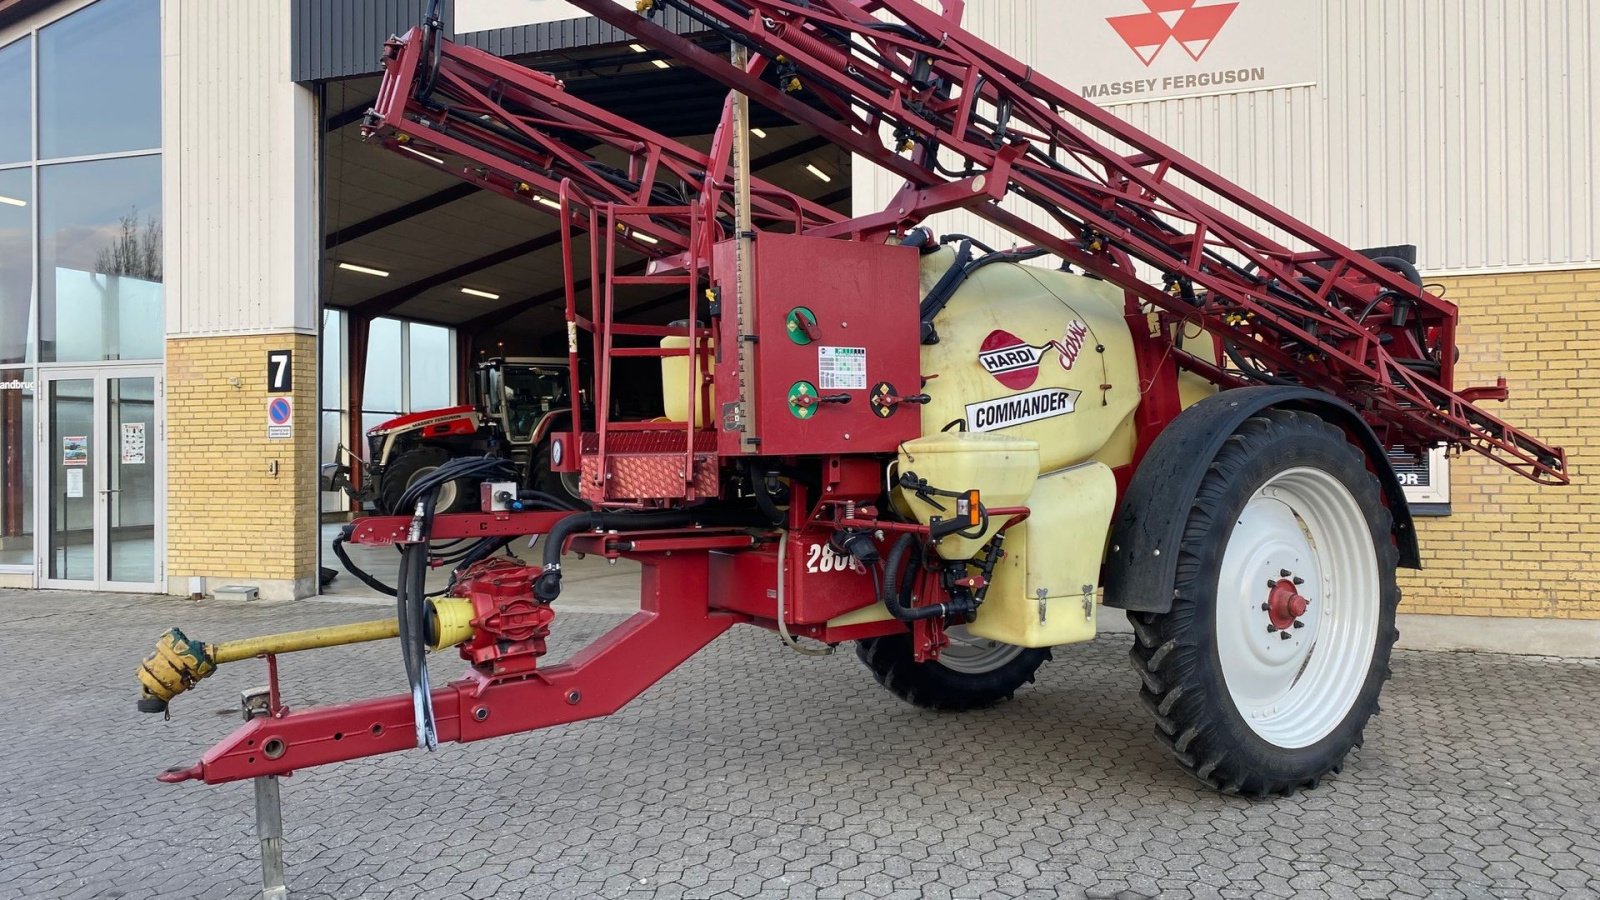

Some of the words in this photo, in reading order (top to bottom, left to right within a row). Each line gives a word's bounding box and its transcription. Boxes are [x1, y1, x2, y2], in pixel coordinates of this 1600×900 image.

[1081, 78, 1157, 98] MASSEY
[1162, 67, 1265, 89] FERGUSON
[271, 355, 288, 388] 7
[983, 348, 1036, 369] HARDI
[976, 392, 1069, 428] COMMANDER
